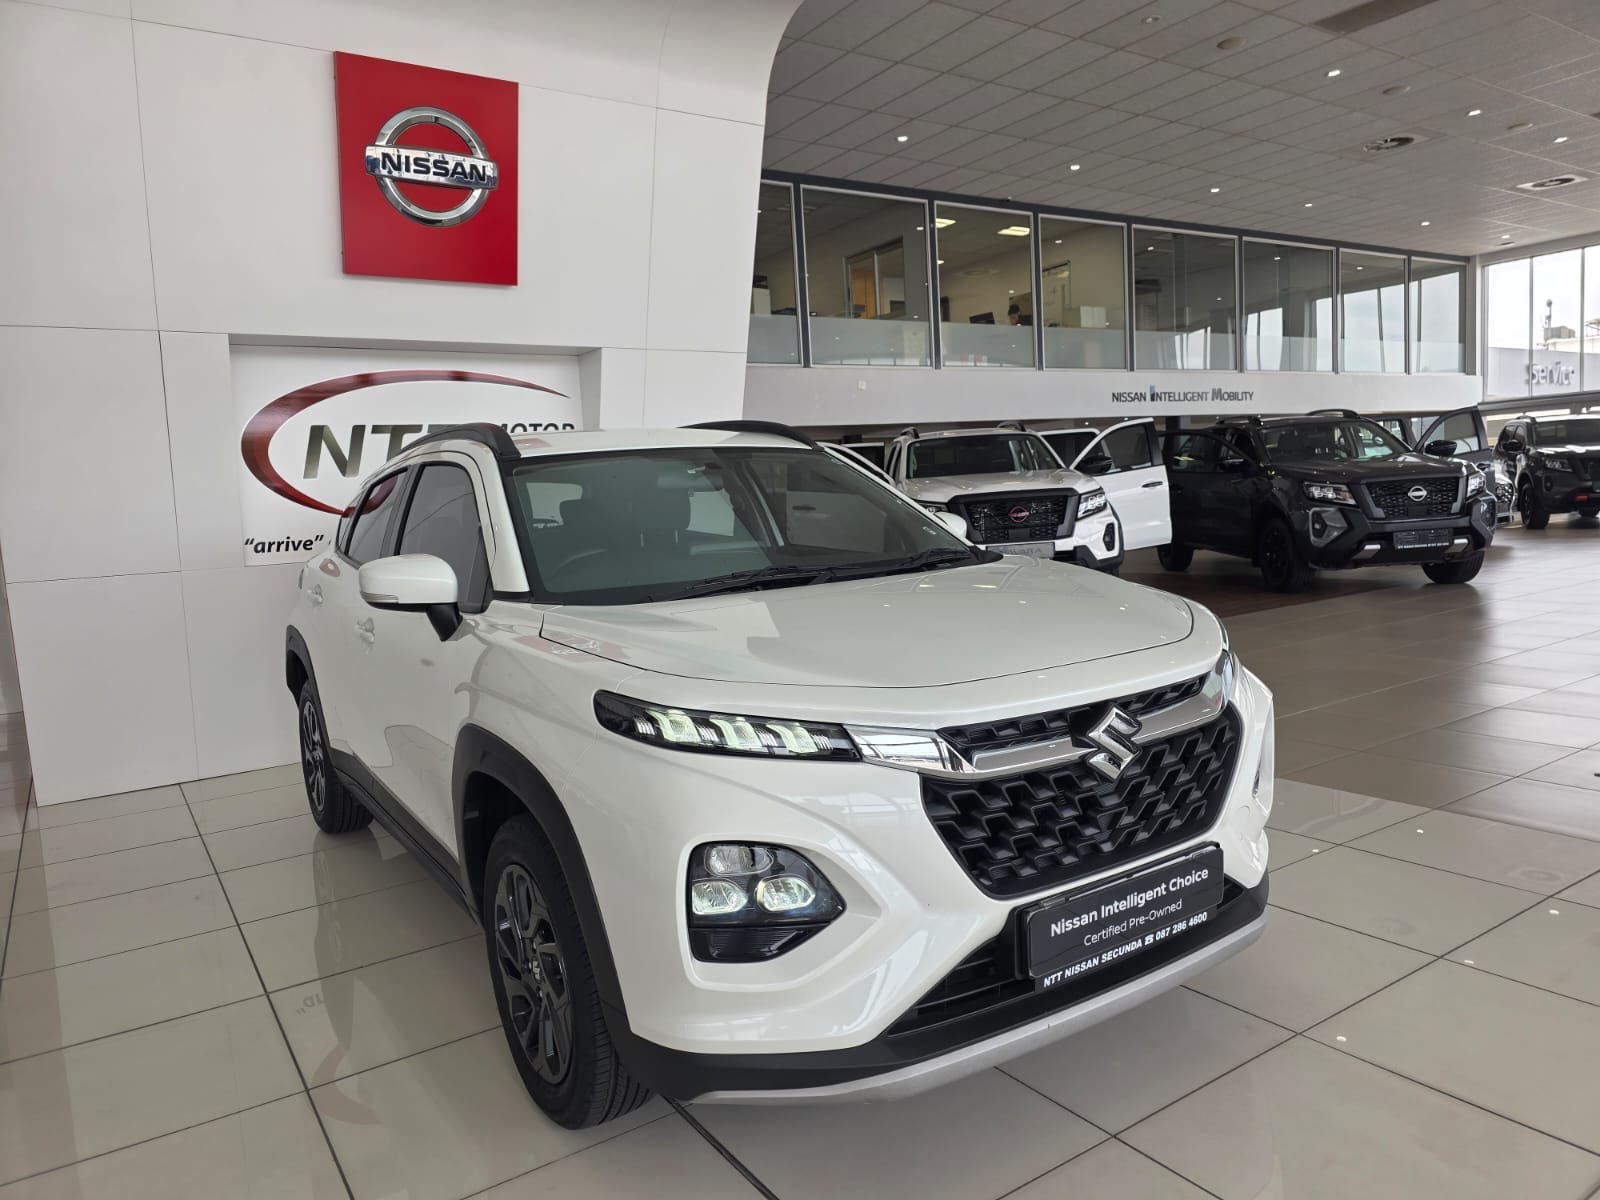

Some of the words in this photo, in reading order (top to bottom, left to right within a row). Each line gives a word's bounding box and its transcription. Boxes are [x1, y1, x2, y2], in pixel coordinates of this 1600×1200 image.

[381, 152, 487, 182] NISSAN
[1112, 391, 1146, 402] NISSAN
[1150, 384, 1210, 402] INTELLIGENT
[1211, 387, 1254, 401] MOBILITY
[303, 425, 458, 479] NT
[1051, 910, 1097, 936] Nissan
[1101, 882, 1166, 919] Intelligent
[1169, 869, 1208, 892] Choice
[1084, 919, 1127, 946] Certified
[1129, 898, 1182, 929] Pre-Owned
[1043, 971, 1063, 988] NTT
[1064, 956, 1100, 979] NISSAN
[1101, 939, 1142, 963] SECUNDA
[1156, 926, 1170, 941] 087
[1172, 920, 1187, 933] 286
[1189, 911, 1207, 927] 4600
